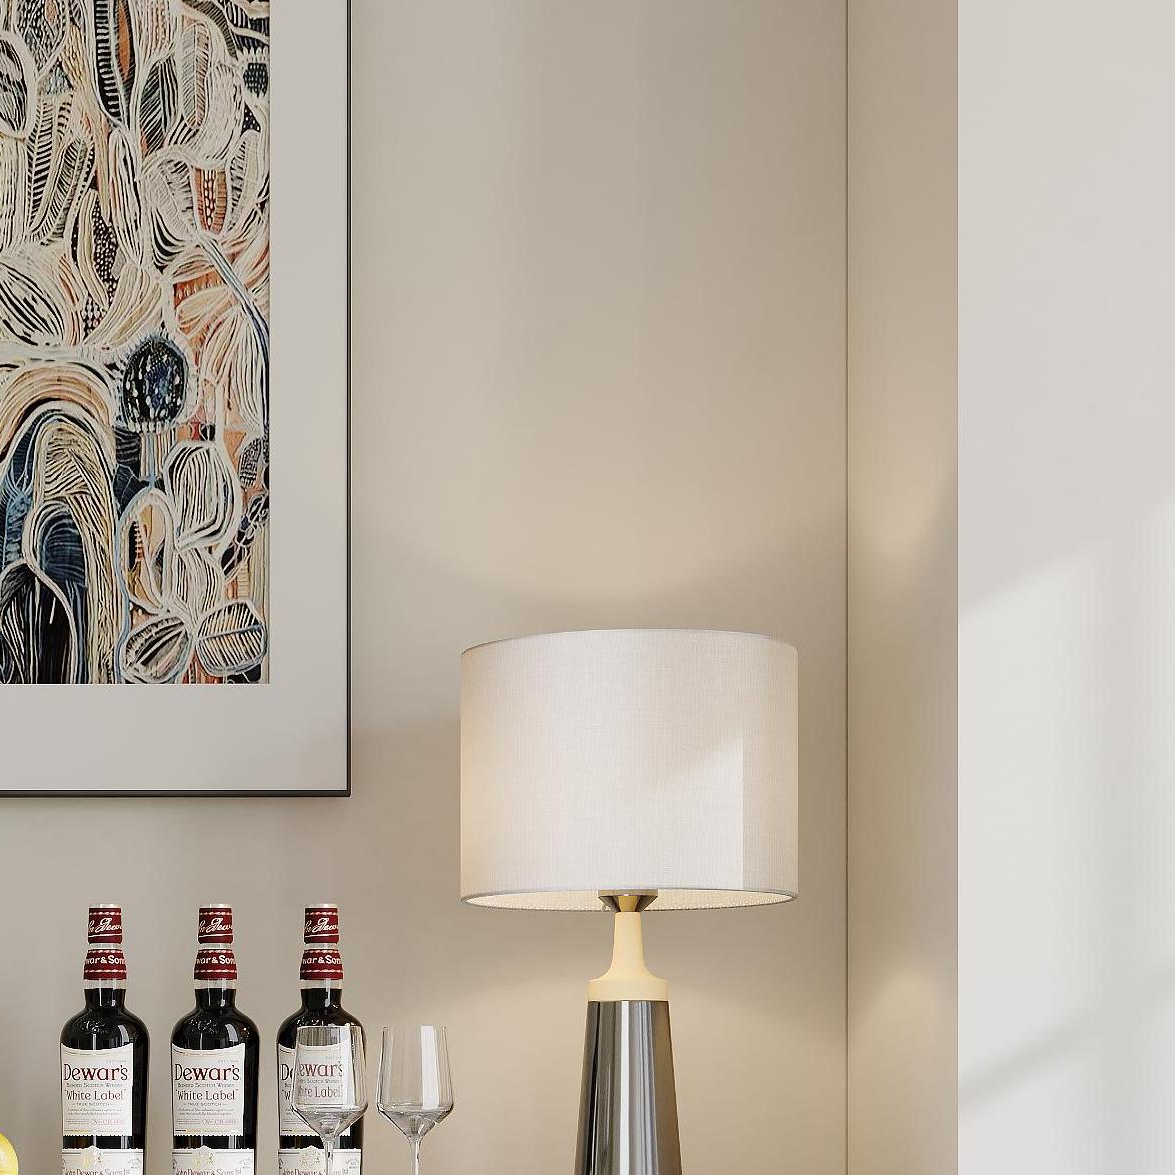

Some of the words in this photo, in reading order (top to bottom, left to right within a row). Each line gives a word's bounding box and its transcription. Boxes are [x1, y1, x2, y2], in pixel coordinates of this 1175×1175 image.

[100, 956, 107, 964] &
[211, 956, 218, 964] &
[318, 956, 325, 964] &
[64, 1063, 128, 1081] Dewar's
[175, 1063, 240, 1081] Dewar's
